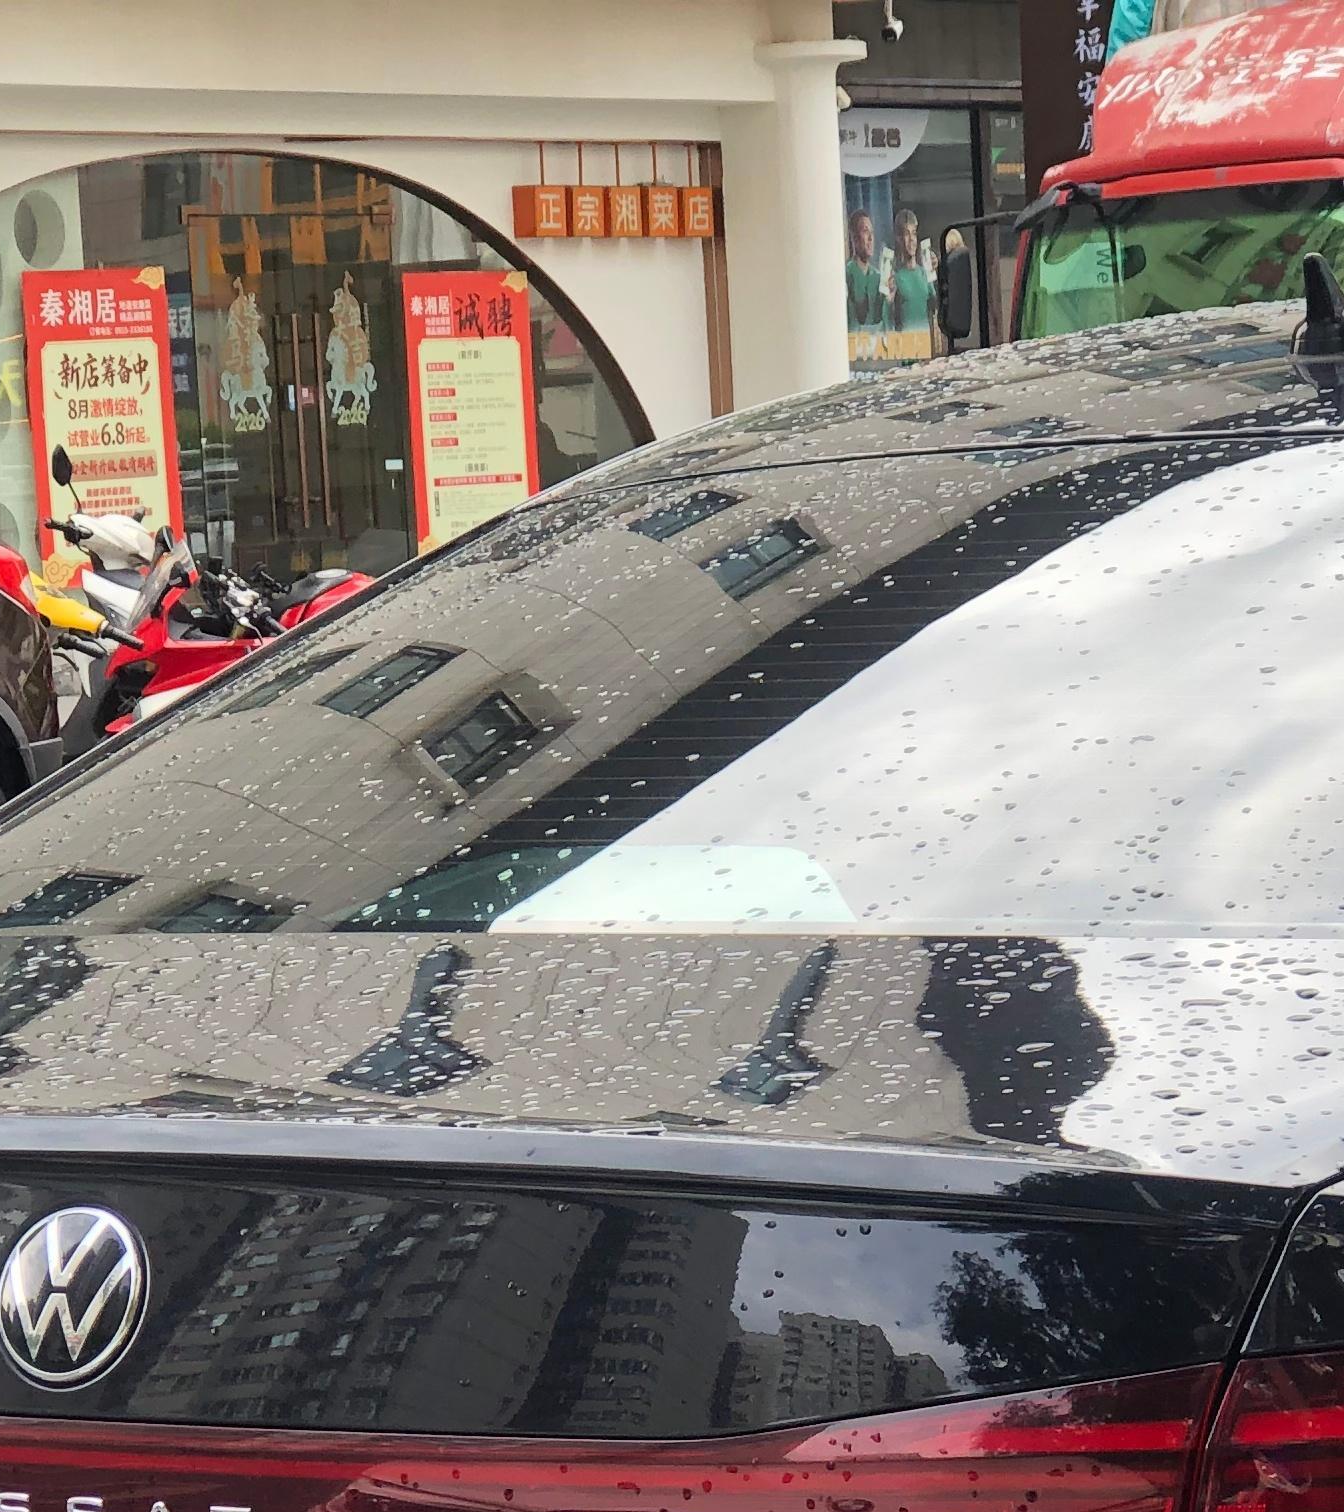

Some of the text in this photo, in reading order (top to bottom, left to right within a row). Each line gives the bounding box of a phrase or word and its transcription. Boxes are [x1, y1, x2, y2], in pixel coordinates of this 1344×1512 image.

[539, 193, 709, 232] 正宗湘菜店
[40, 288, 116, 327] 秦湘居
[410, 295, 450, 317] 秦湘居
[58, 352, 149, 392] 新店筹备中
